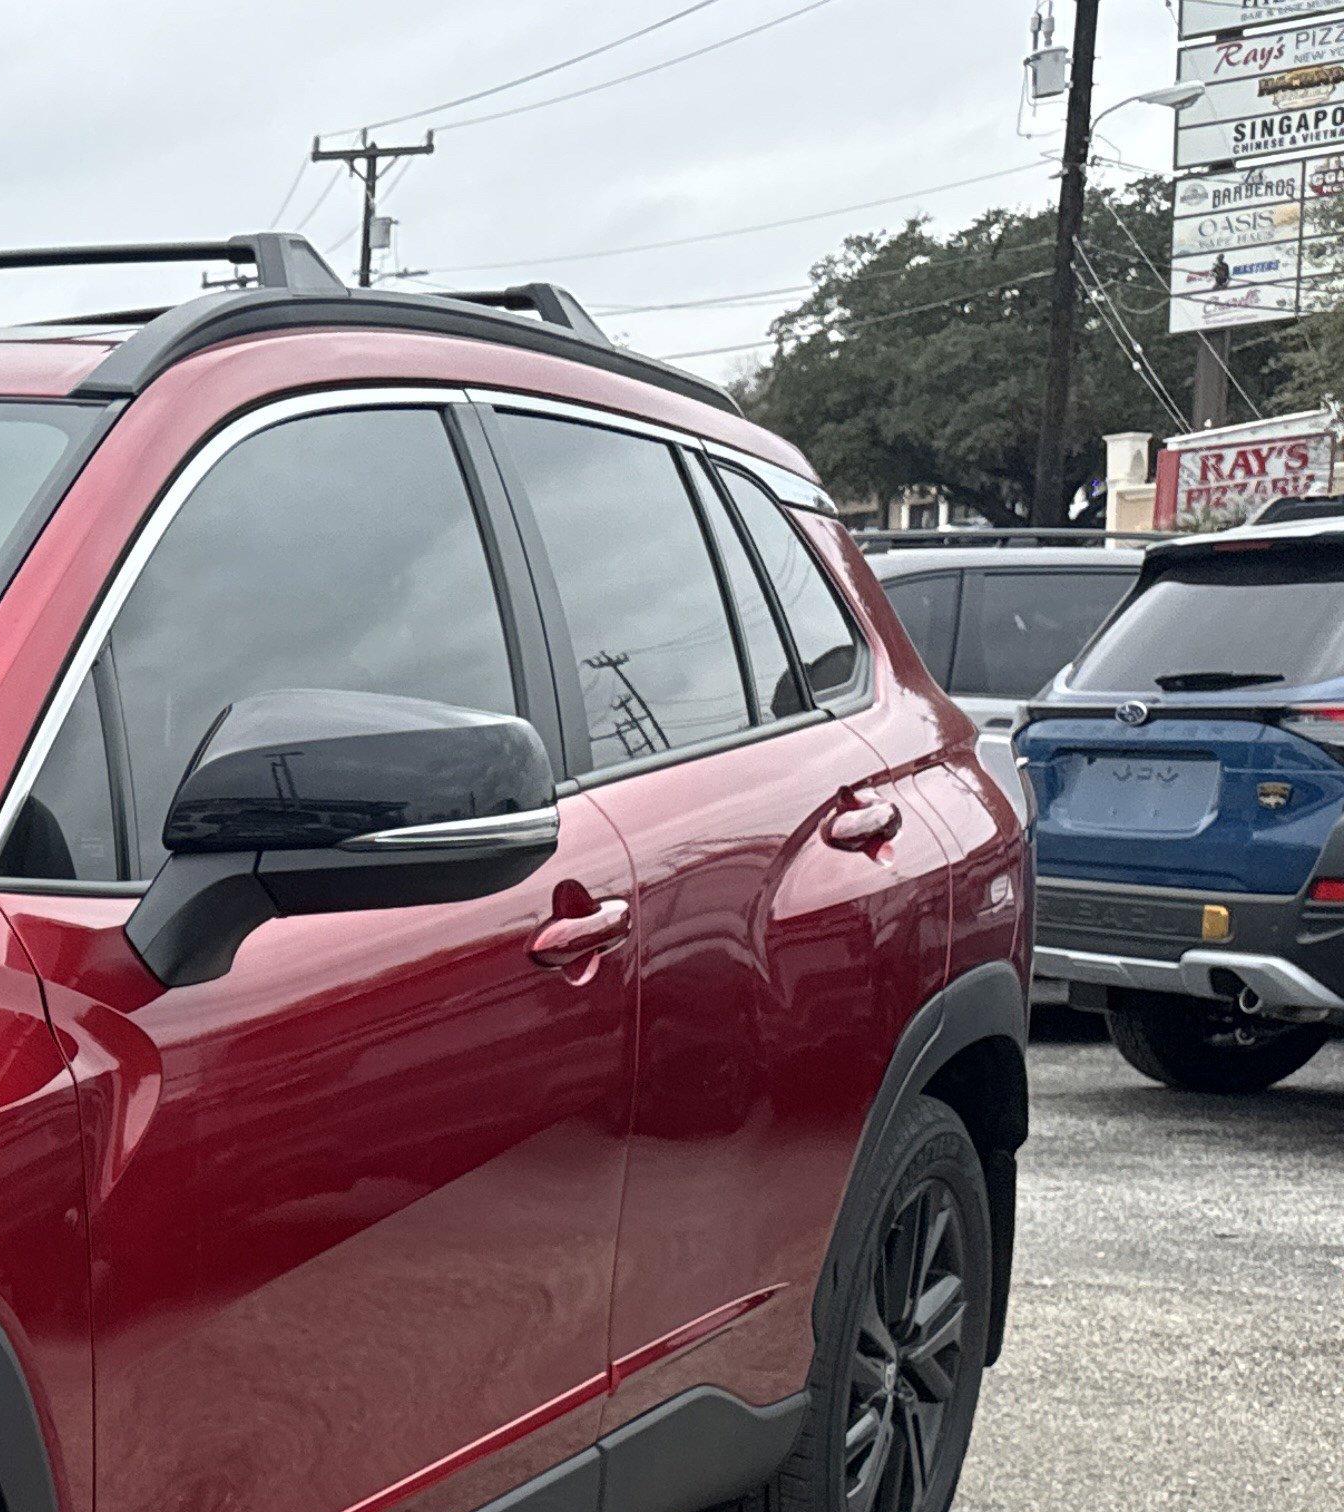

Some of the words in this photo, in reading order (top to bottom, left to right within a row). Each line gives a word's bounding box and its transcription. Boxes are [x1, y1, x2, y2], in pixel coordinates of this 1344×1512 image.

[1295, 23, 1344, 49] PIZZ
[1214, 36, 1285, 74] Ray's
[1294, 51, 1325, 64] NEW
[1233, 107, 1344, 142] SINGAPO
[1233, 138, 1284, 154] CHINESE
[1289, 135, 1296, 146] &
[1198, 210, 1275, 237] OASIS
[1200, 443, 1309, 481] RAY'S
